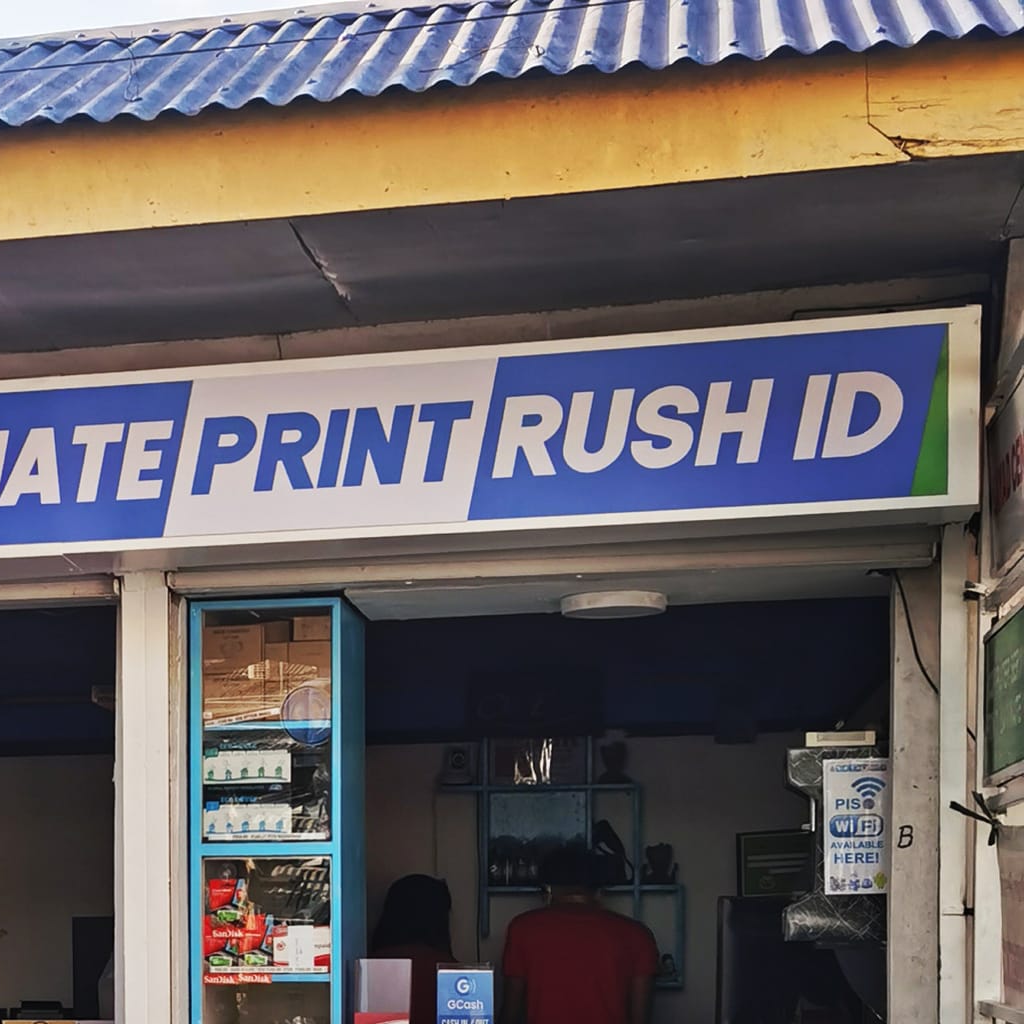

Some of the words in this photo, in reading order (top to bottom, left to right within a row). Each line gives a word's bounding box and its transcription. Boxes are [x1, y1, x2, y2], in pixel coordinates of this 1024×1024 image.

[190, 399, 473, 496] PRINT
[491, 377, 774, 479] RUSH
[792, 370, 904, 461] ID
[897, 825, 914, 849] B
[831, 841, 884, 849] AVAILABLE
[834, 852, 879, 864] HERE!
[212, 929, 244, 938] SanDisk
[203, 975, 235, 984] SanDisk
[238, 973, 270, 983] SanDisk
[447, 999, 484, 1010] GCash
